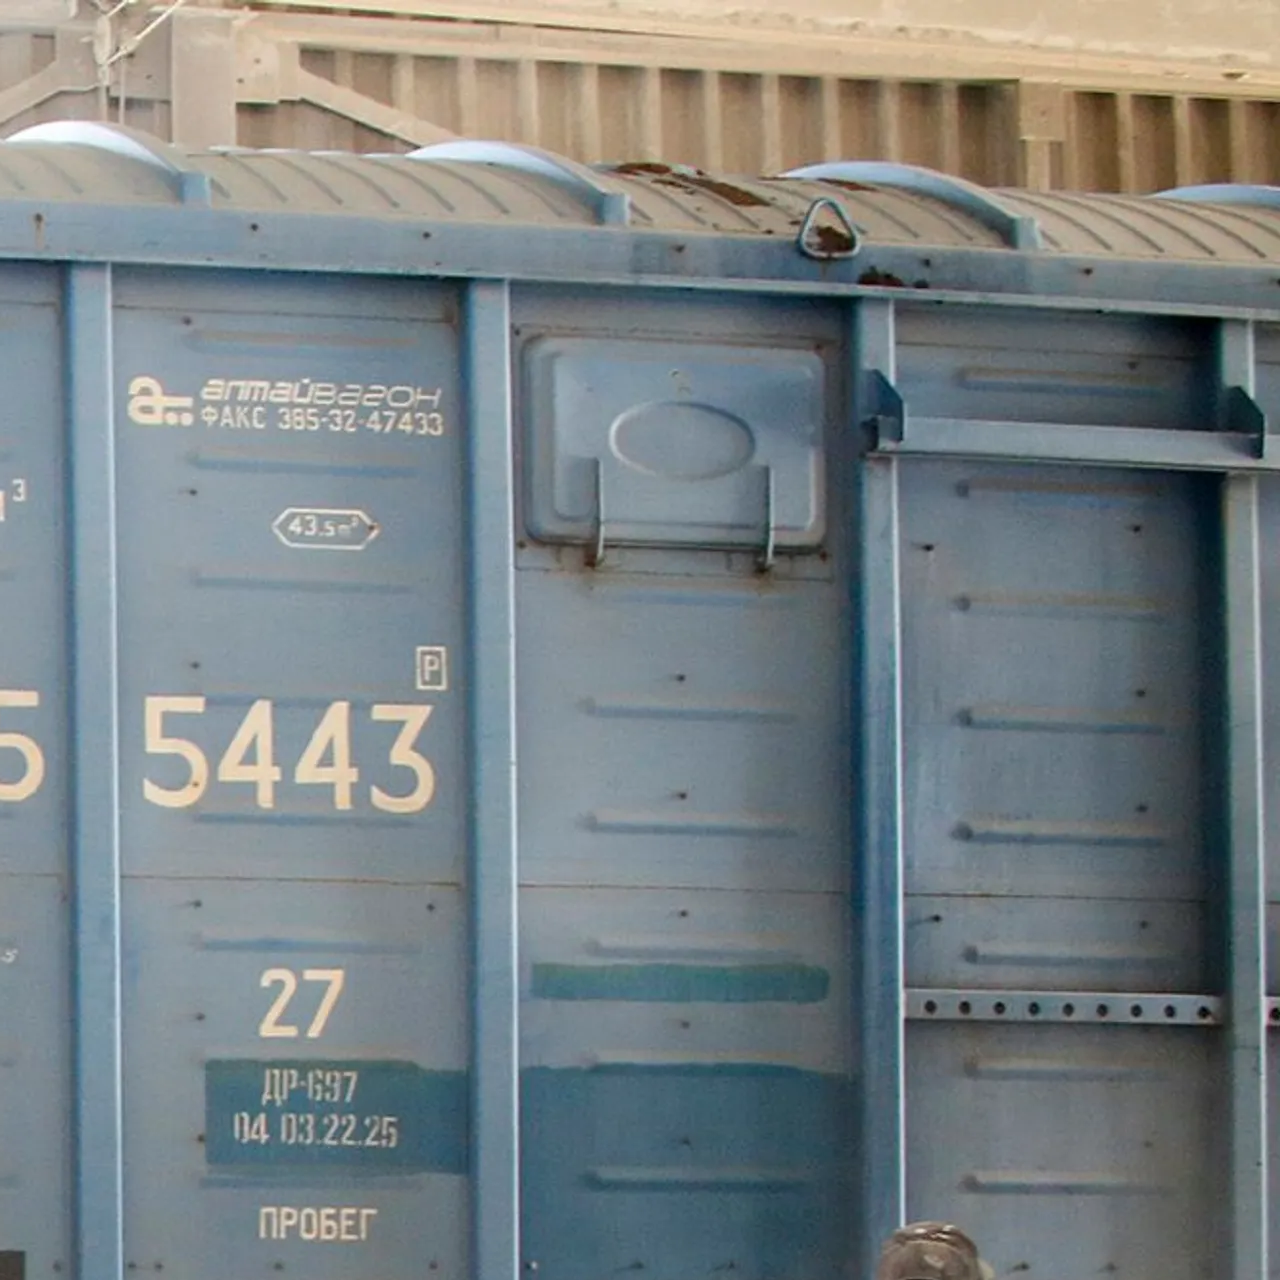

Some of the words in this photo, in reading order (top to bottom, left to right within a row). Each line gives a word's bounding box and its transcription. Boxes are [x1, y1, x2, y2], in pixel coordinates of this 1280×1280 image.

[201, 407, 266, 430] ФАКС
[143, 697, 435, 812] 5443
[259, 969, 344, 1037] 27
[234, 1112, 269, 1144] 04
[258, 1207, 378, 1241] ПРОБЕГ
